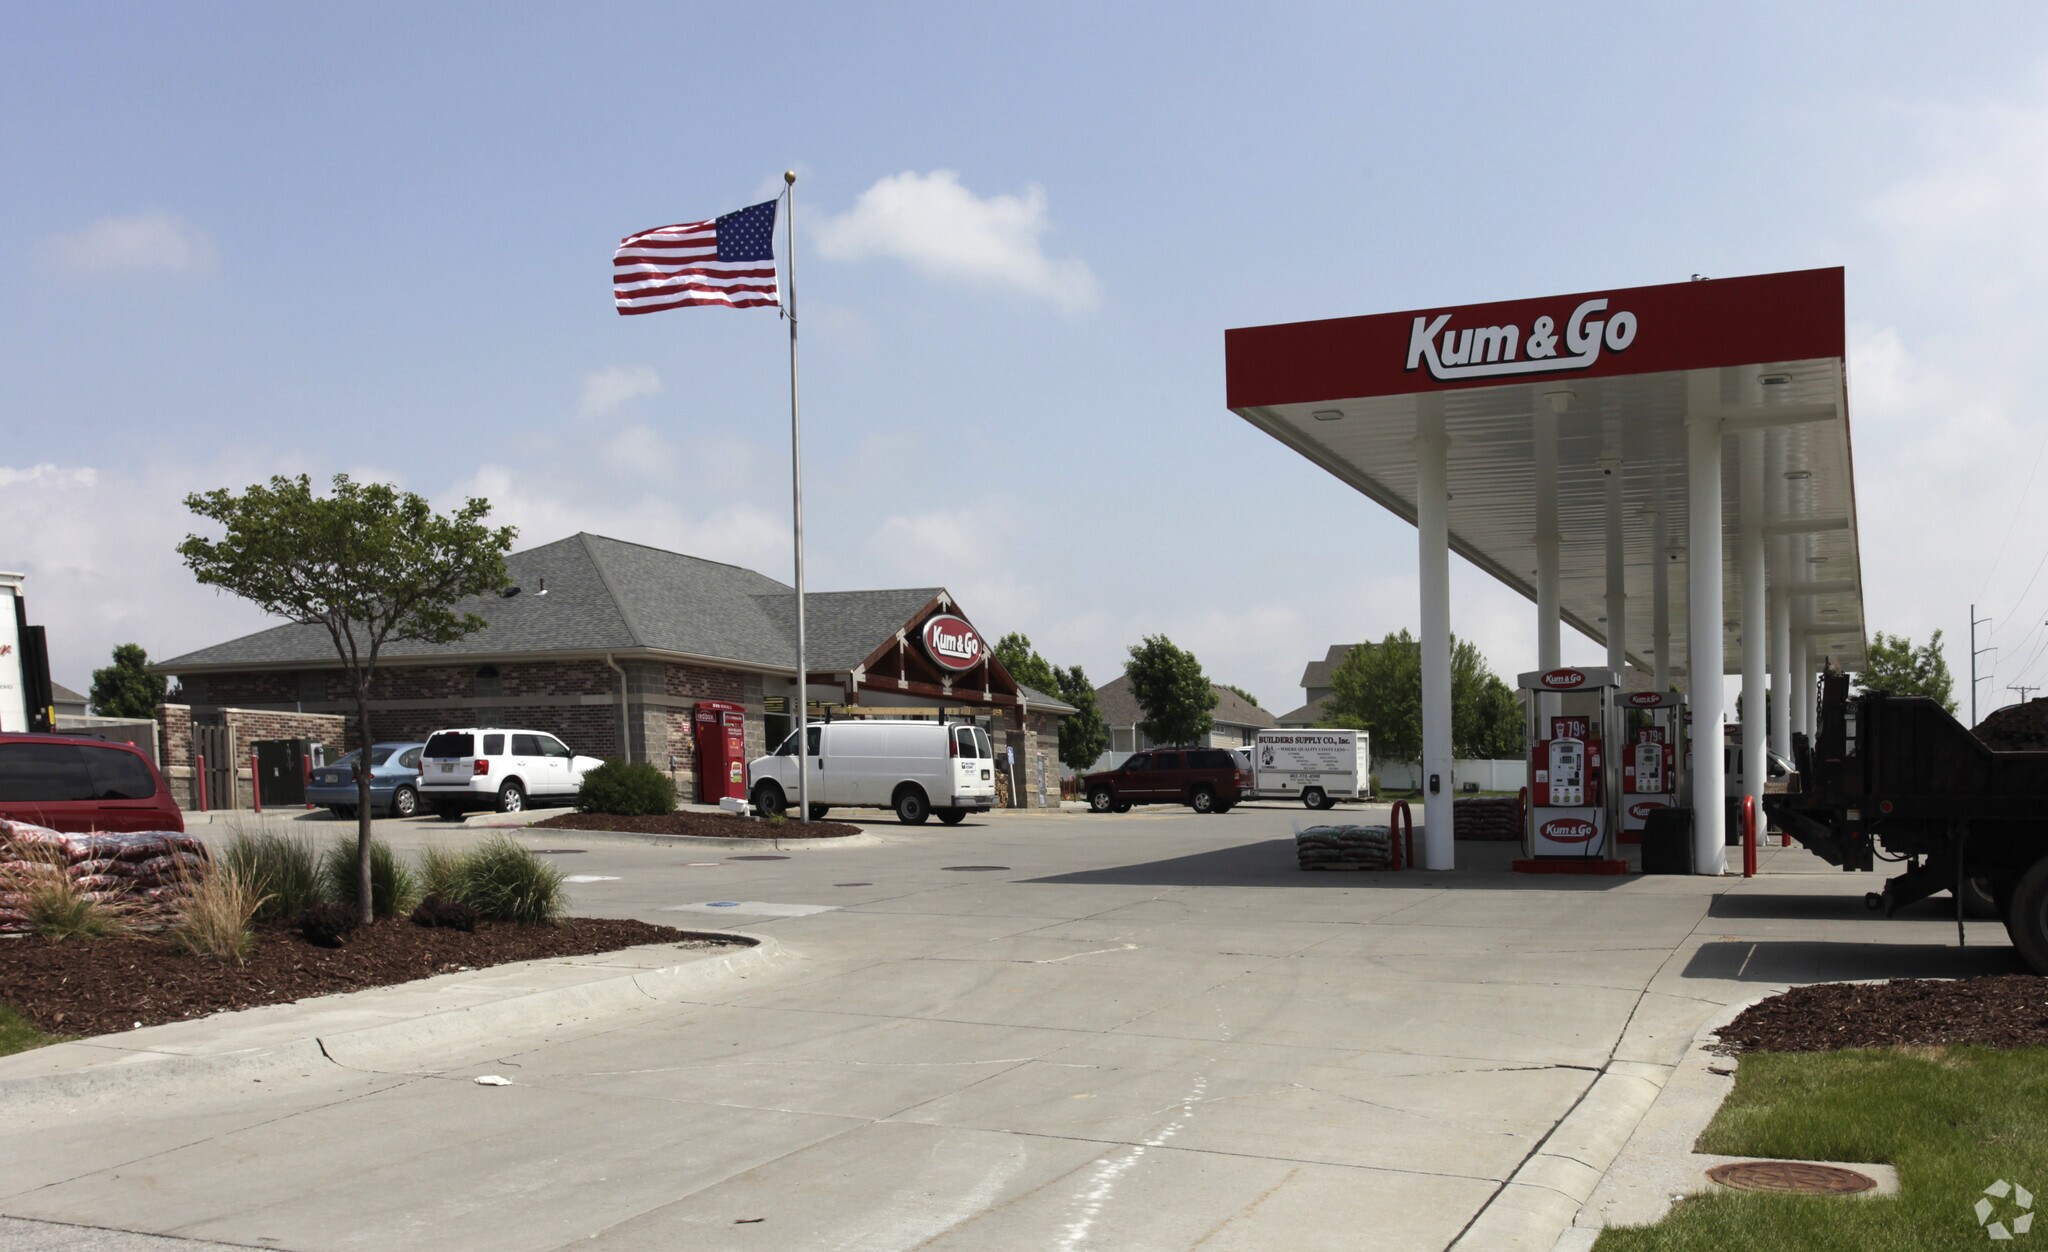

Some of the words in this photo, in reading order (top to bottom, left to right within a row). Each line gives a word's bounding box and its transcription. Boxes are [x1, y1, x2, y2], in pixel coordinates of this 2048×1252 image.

[1406, 314, 1519, 380] Kum
[1526, 315, 1559, 360] &
[1566, 298, 1638, 369] Go
[933, 625, 957, 655] Kum
[957, 635, 964, 653] &
[965, 632, 978, 659] Go
[1546, 675, 1564, 684] Kum
[1570, 674, 1582, 683] Go
[1632, 695, 1646, 703] Kum
[1567, 720, 1586, 737] 79¢
[1259, 736, 1294, 744] BUILDERS
[1295, 736, 1322, 744] SUPPLY
[1323, 736, 1337, 745] CO.,
[1338, 736, 1351, 745] Inc.
[1546, 824, 1570, 836] Kum
[1570, 826, 1577, 834] &
[1578, 824, 1592, 836] Go
